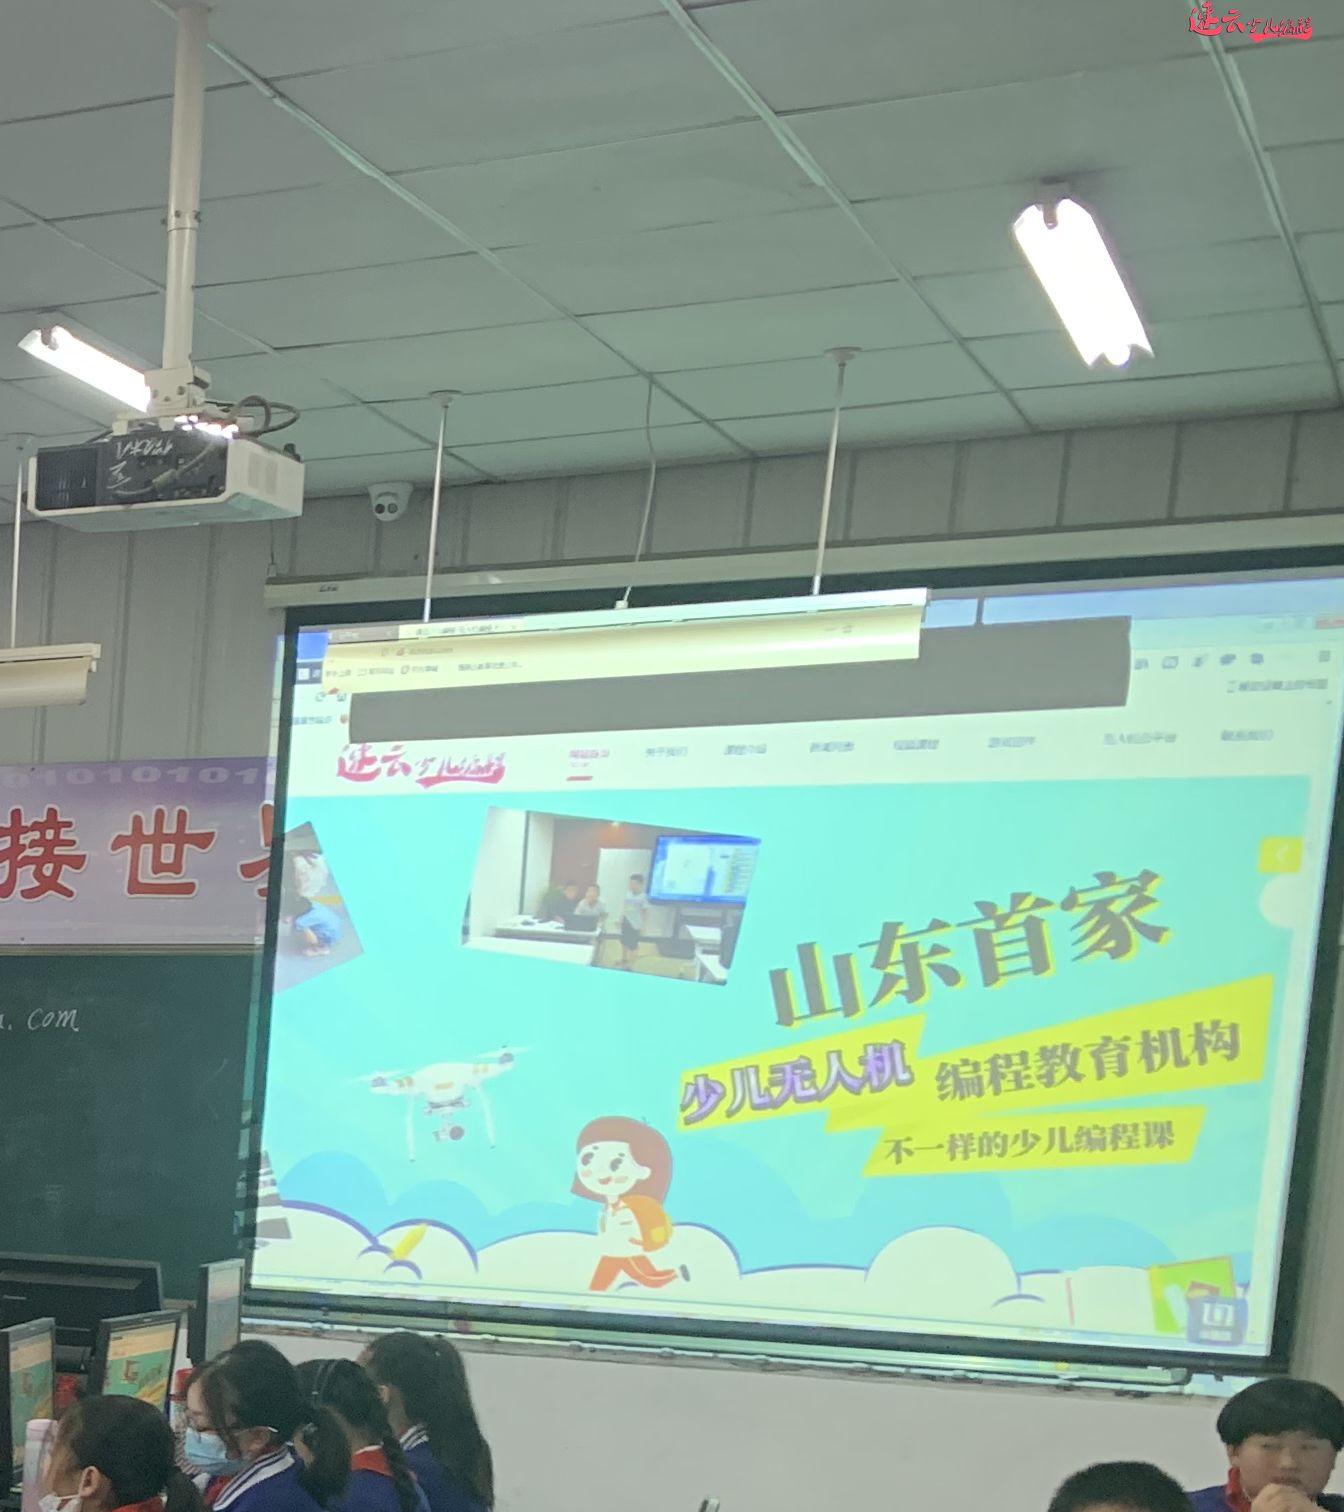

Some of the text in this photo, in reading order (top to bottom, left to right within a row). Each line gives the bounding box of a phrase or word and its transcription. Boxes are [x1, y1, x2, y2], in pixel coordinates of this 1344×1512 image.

[768, 868, 1173, 1028] 山东首家
[680, 1018, 1241, 1126] 少儿无人机 编程教育机构
[883, 1119, 1176, 1166] 不一样的少儿编程课
